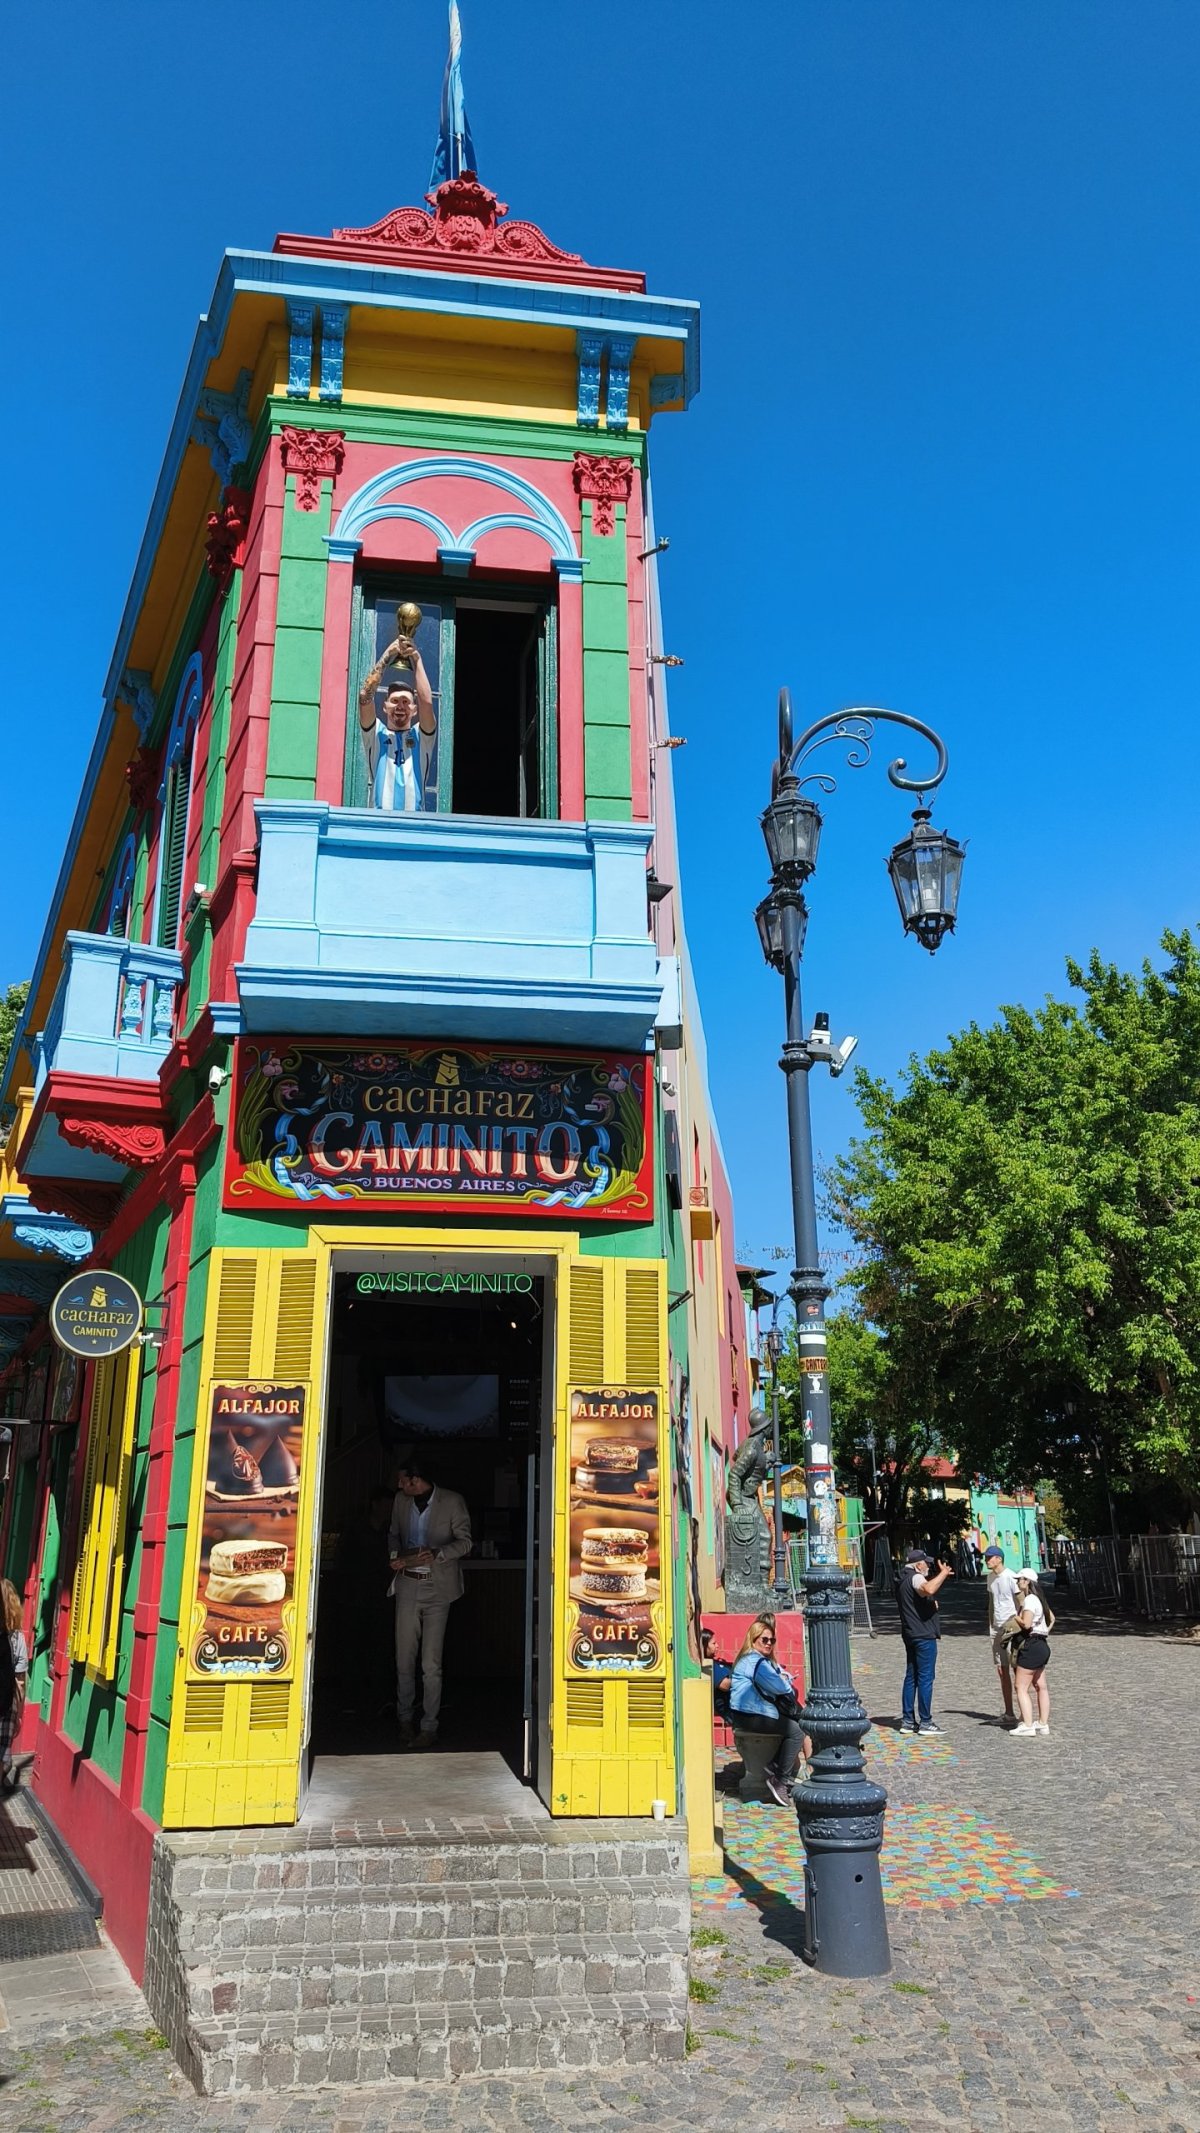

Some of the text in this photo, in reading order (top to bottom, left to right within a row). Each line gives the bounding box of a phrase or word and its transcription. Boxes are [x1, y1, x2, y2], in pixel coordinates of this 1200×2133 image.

[308, 1112, 582, 1182] CAMINITO
[374, 1176, 516, 1192] BUENOS AIRES
[356, 1271, 533, 1294] @VISITCAMINITO
[73, 1325, 118, 1338] CAMINITO
[218, 1398, 300, 1414] ALFAJOR
[577, 1403, 654, 1418] ALFAJOR
[219, 1625, 268, 1642] CAFE
[592, 1624, 639, 1641] CAFE
